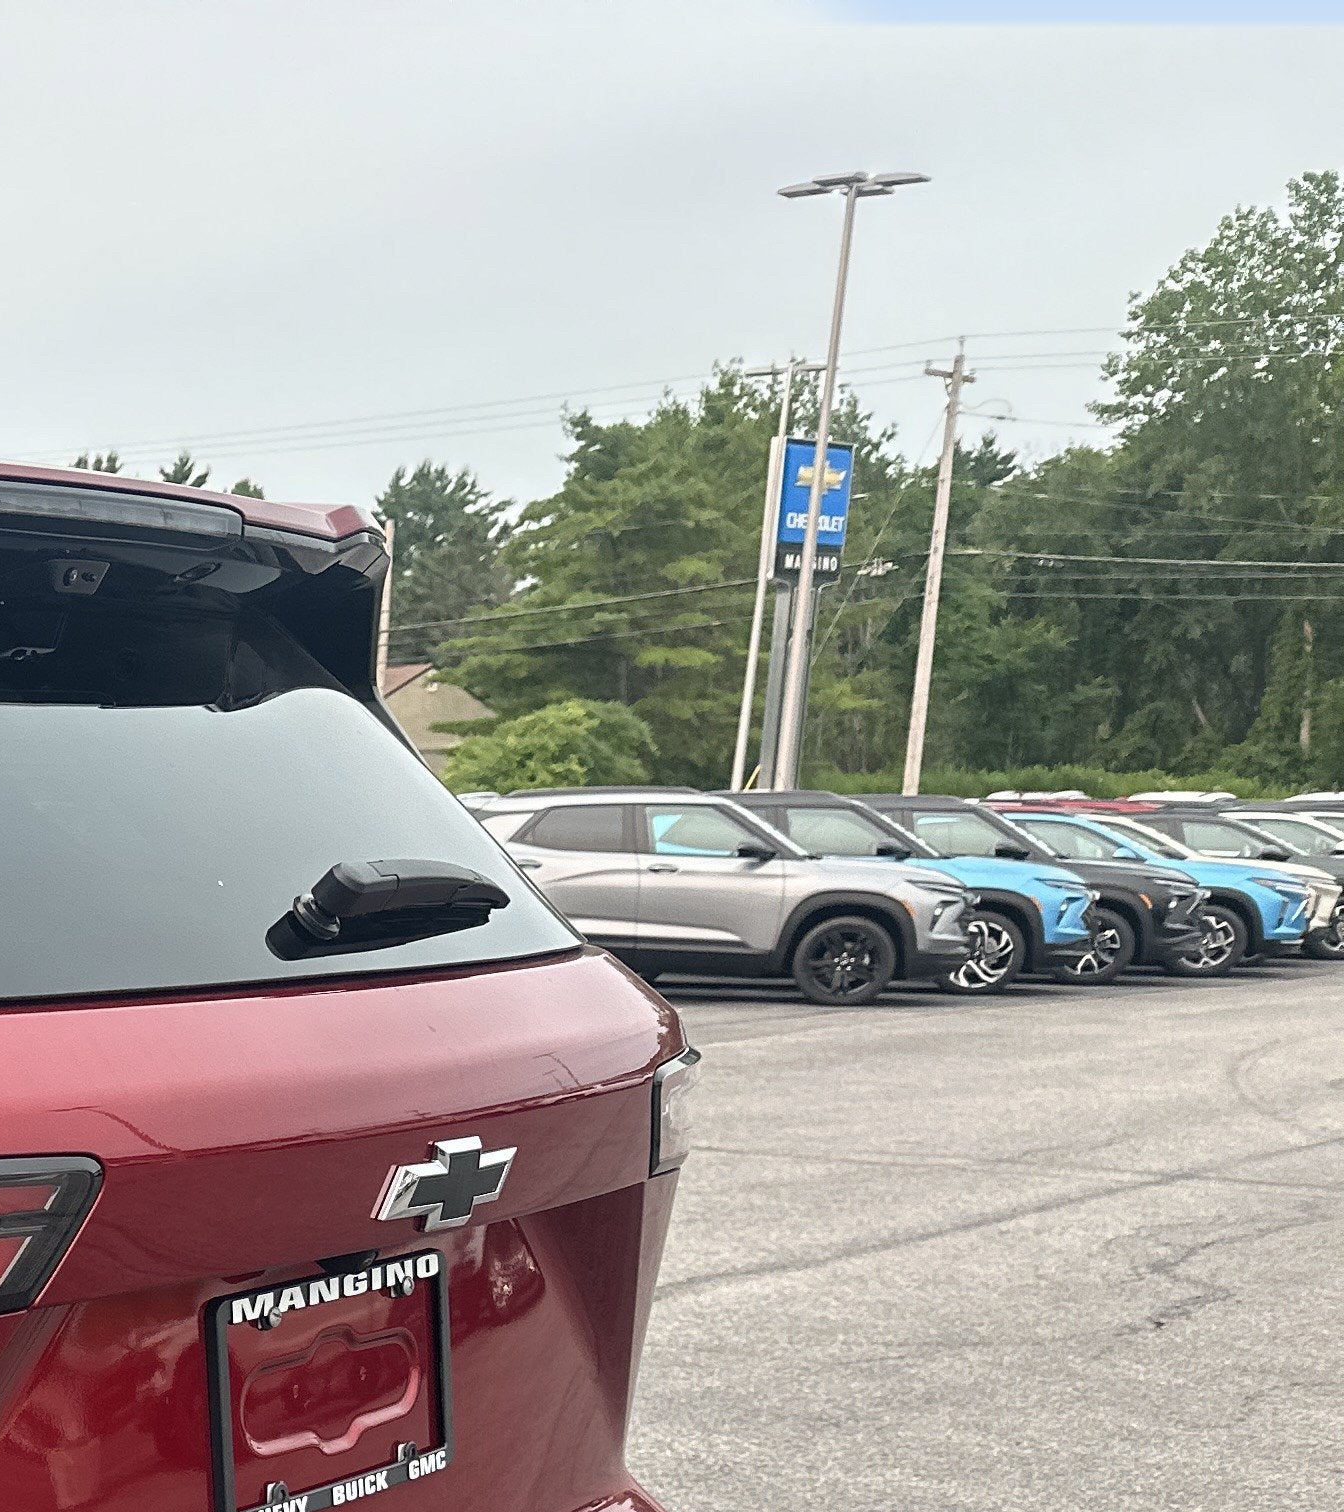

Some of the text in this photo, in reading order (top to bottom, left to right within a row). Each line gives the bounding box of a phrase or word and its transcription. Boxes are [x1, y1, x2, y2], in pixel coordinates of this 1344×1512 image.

[785, 512, 845, 533] CHEOLET
[231, 1253, 440, 1325] MANGINO
[331, 1470, 389, 1507] BUICK
[407, 1450, 447, 1481] GMC
